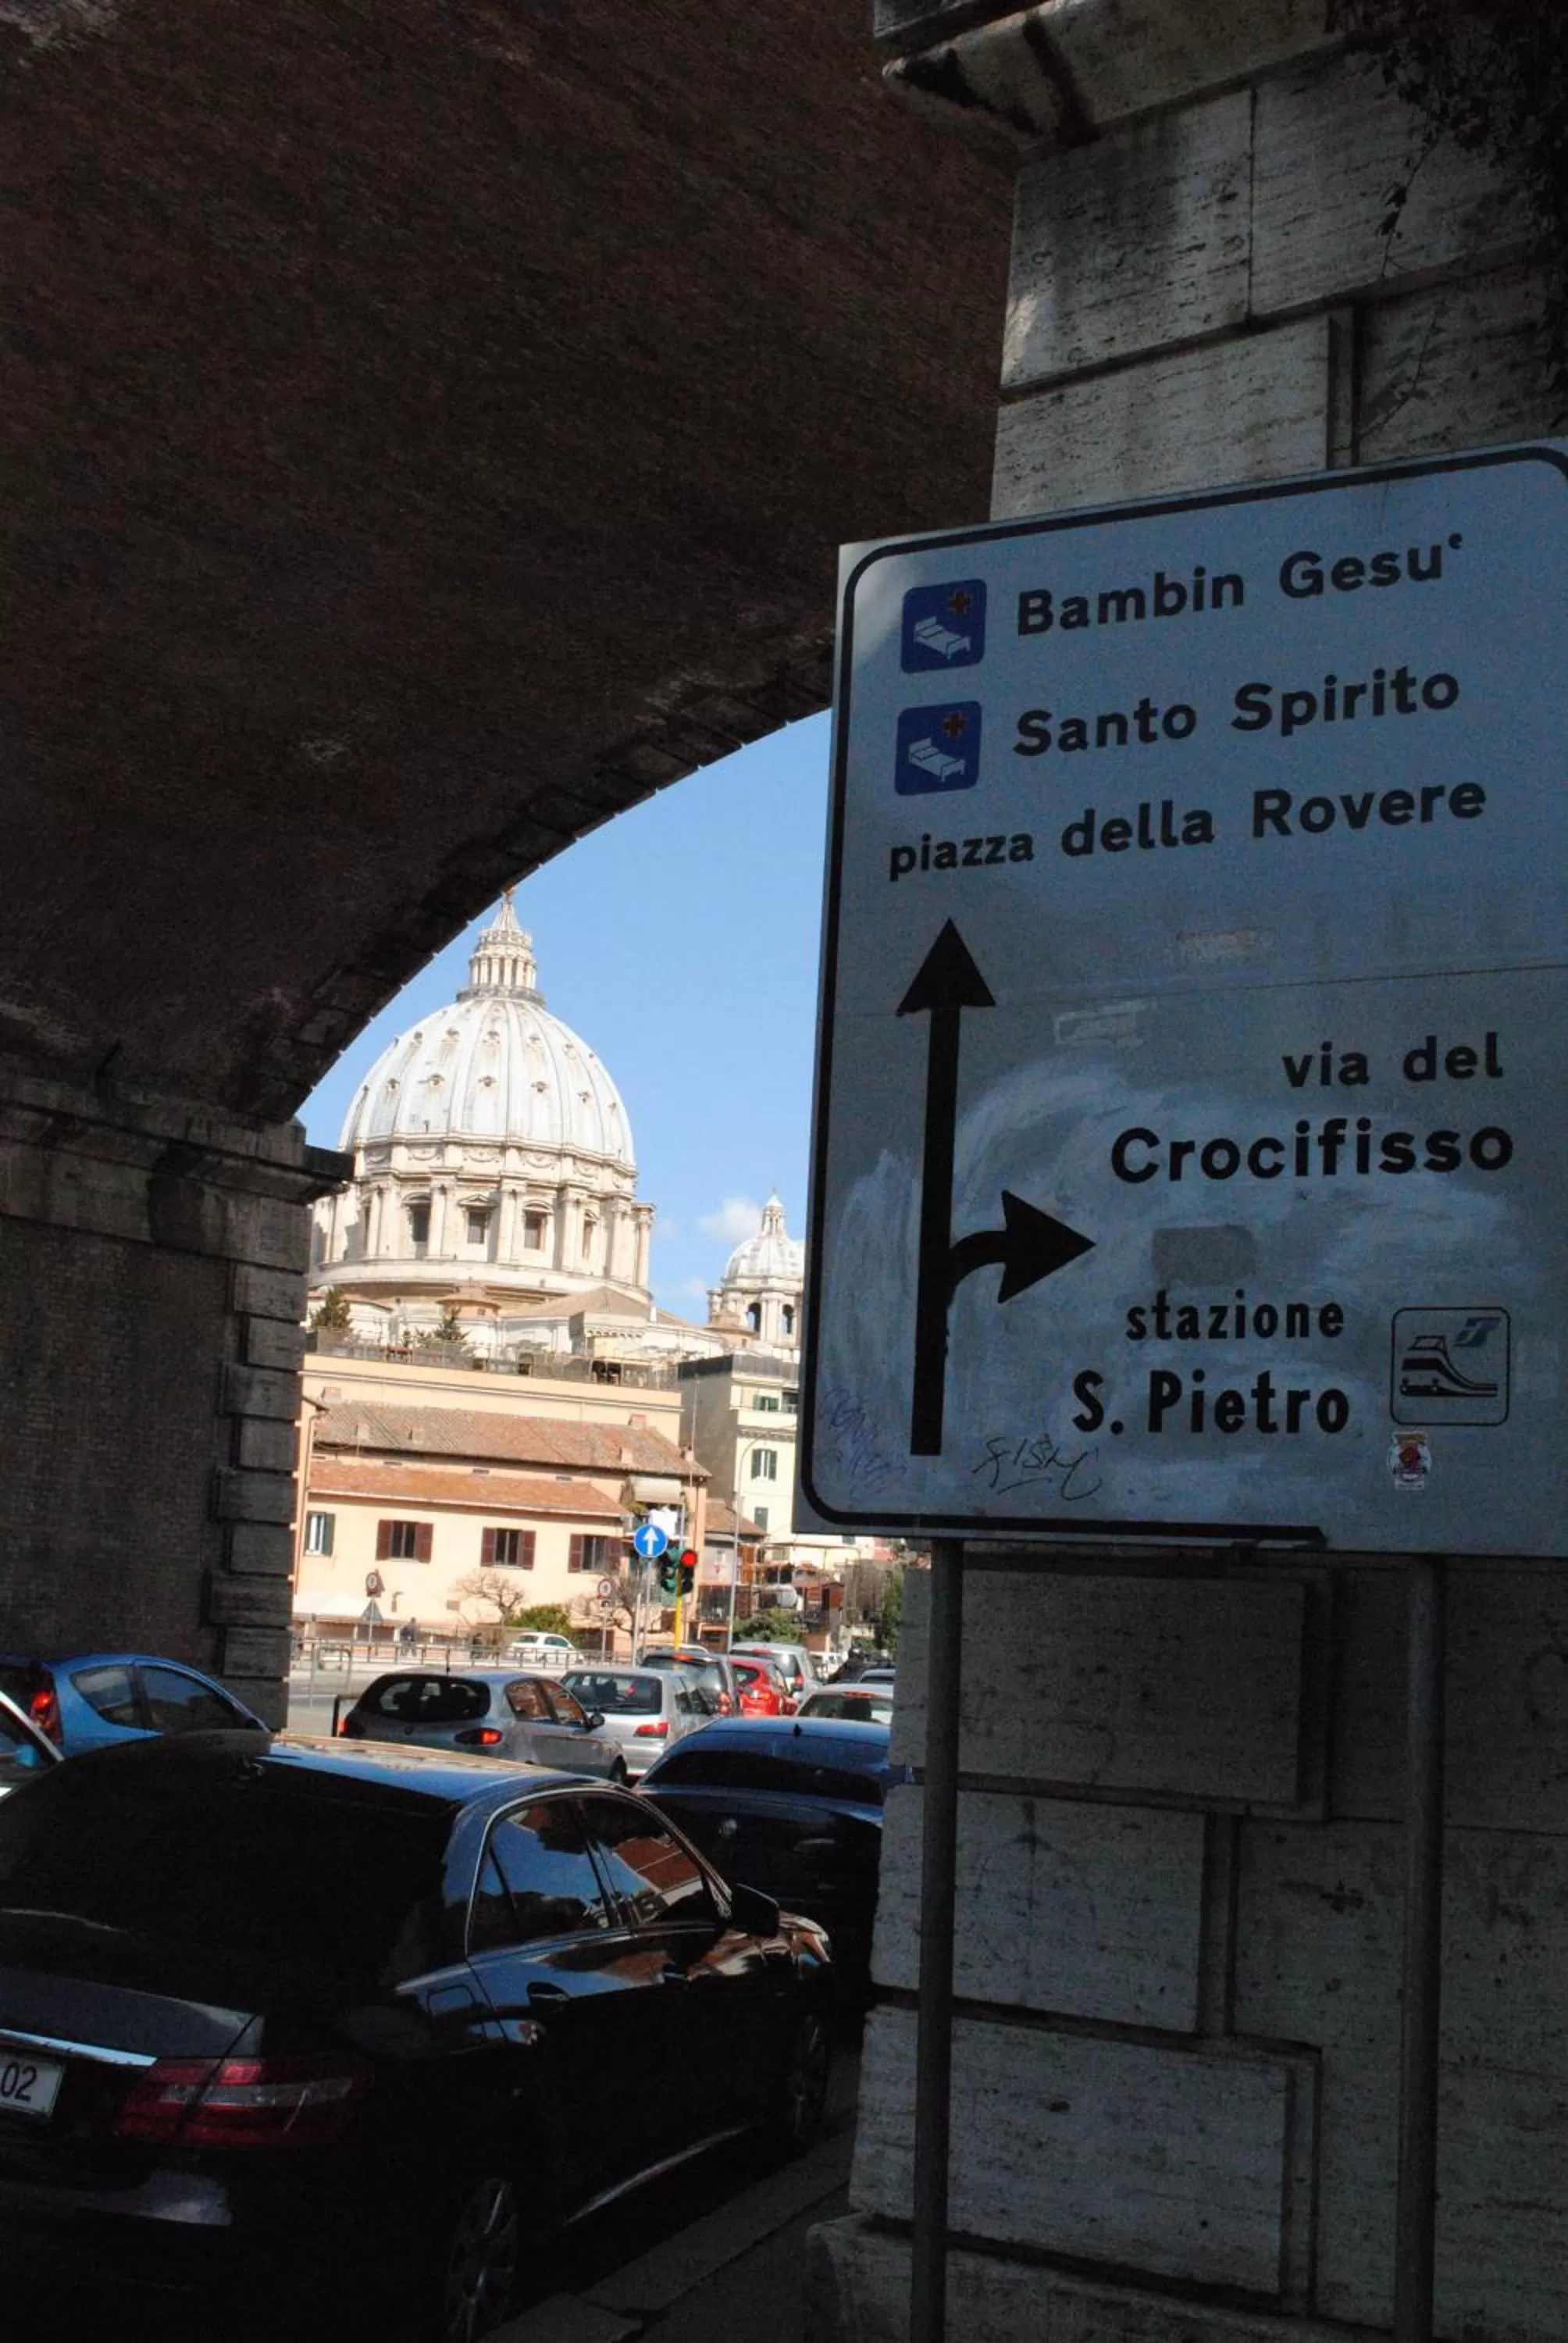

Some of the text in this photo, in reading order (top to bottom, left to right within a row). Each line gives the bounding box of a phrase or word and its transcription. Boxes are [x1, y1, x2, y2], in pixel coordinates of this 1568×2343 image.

[1018, 566, 1243, 635] Bambin
[1014, 666, 1459, 756] Santo Spirito
[889, 783, 1486, 882] piazza della Rovere
[1283, 1032, 1503, 1087] via del
[1111, 1118, 1513, 1183] Crocifisso
[1127, 1289, 1344, 1340] stazione
[1073, 1369, 1349, 1435] S. Pietro
